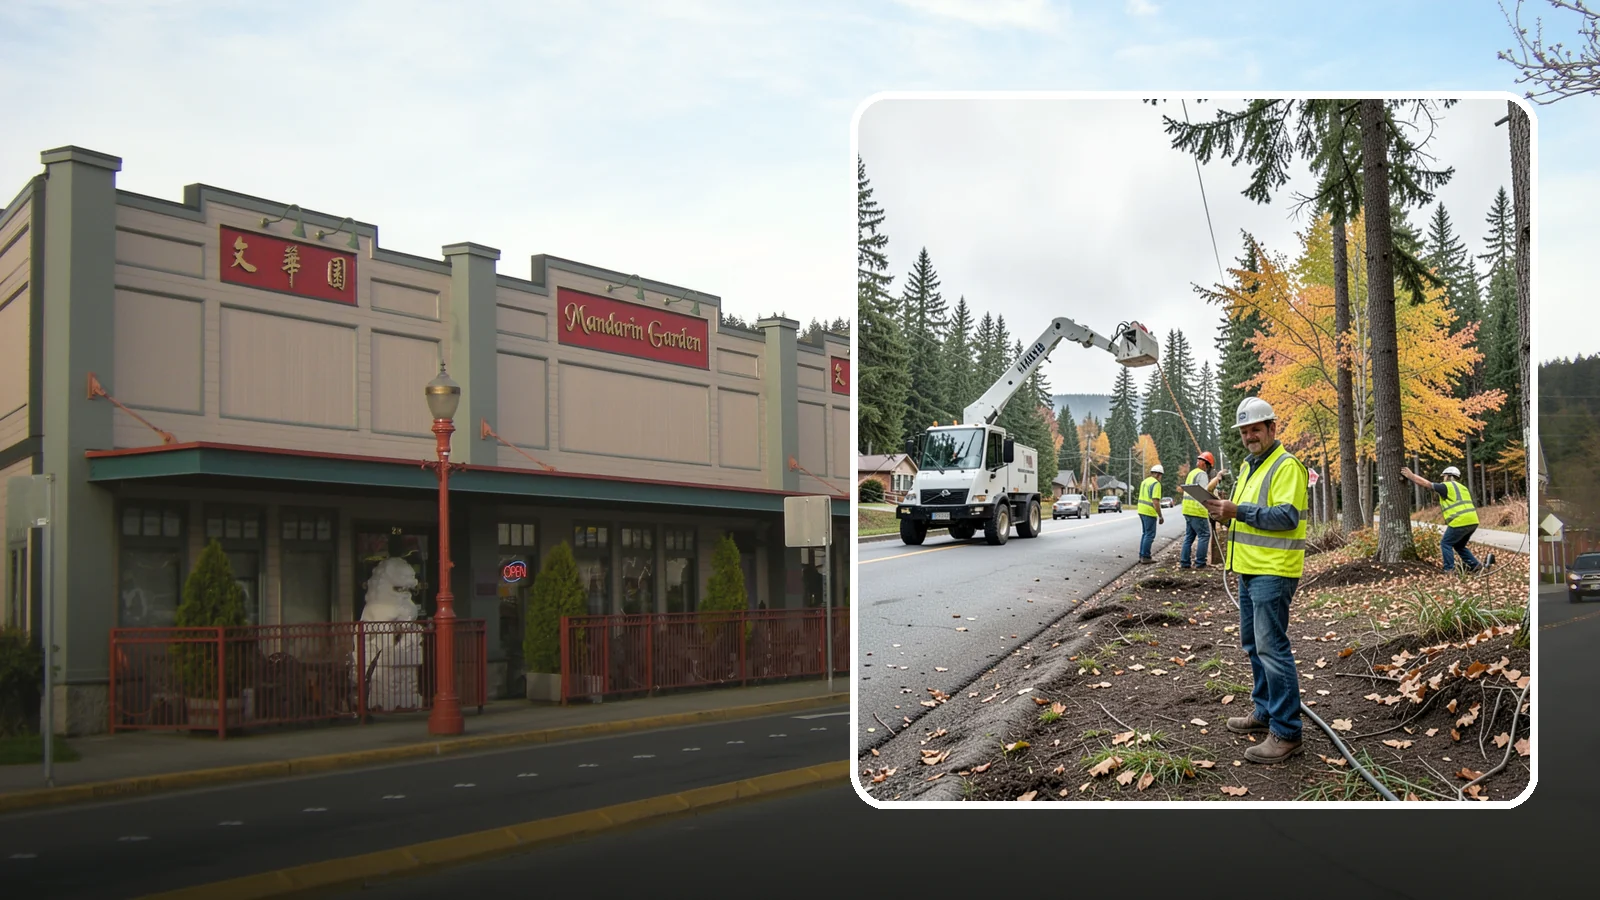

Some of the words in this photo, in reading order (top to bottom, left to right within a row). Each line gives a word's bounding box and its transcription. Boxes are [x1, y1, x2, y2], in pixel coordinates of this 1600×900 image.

[564, 302, 644, 341] Mandarin
[648, 320, 701, 352] Garden
[503, 565, 527, 578] OPEN
